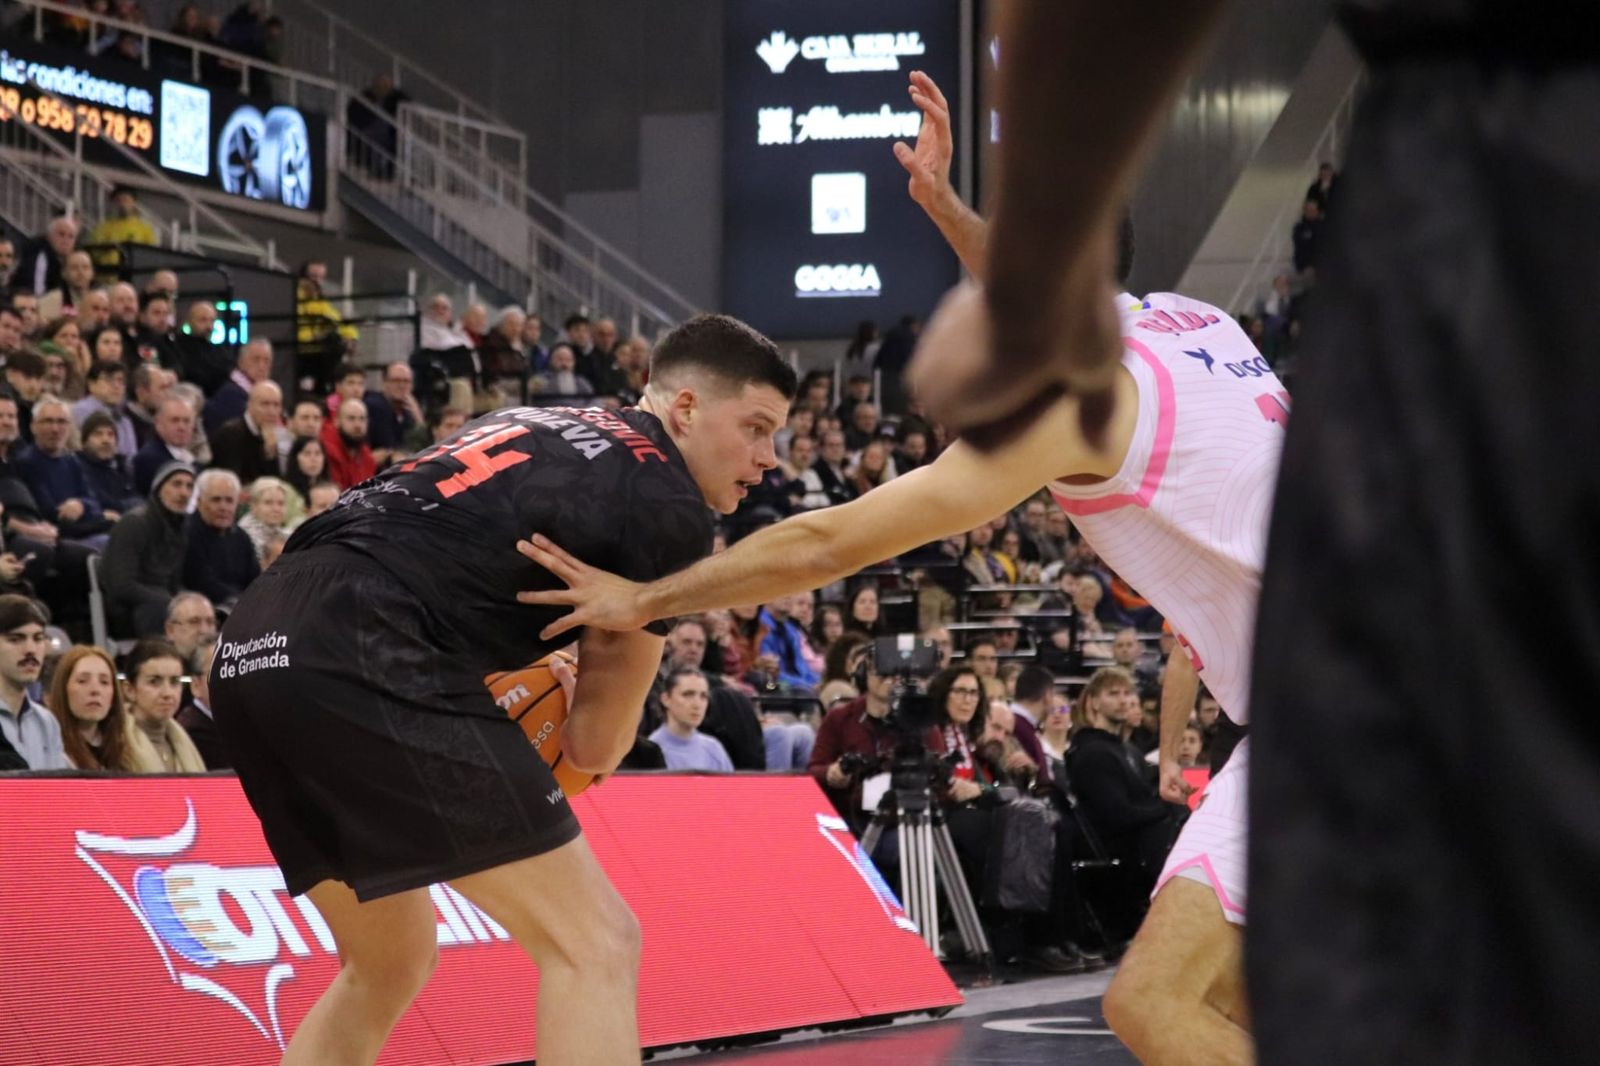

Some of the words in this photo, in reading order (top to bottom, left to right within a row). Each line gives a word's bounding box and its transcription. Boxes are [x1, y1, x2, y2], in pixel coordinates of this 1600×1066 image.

[221, 631, 287, 661] Diputación
[219, 661, 236, 679] de
[238, 650, 290, 676] Granada
